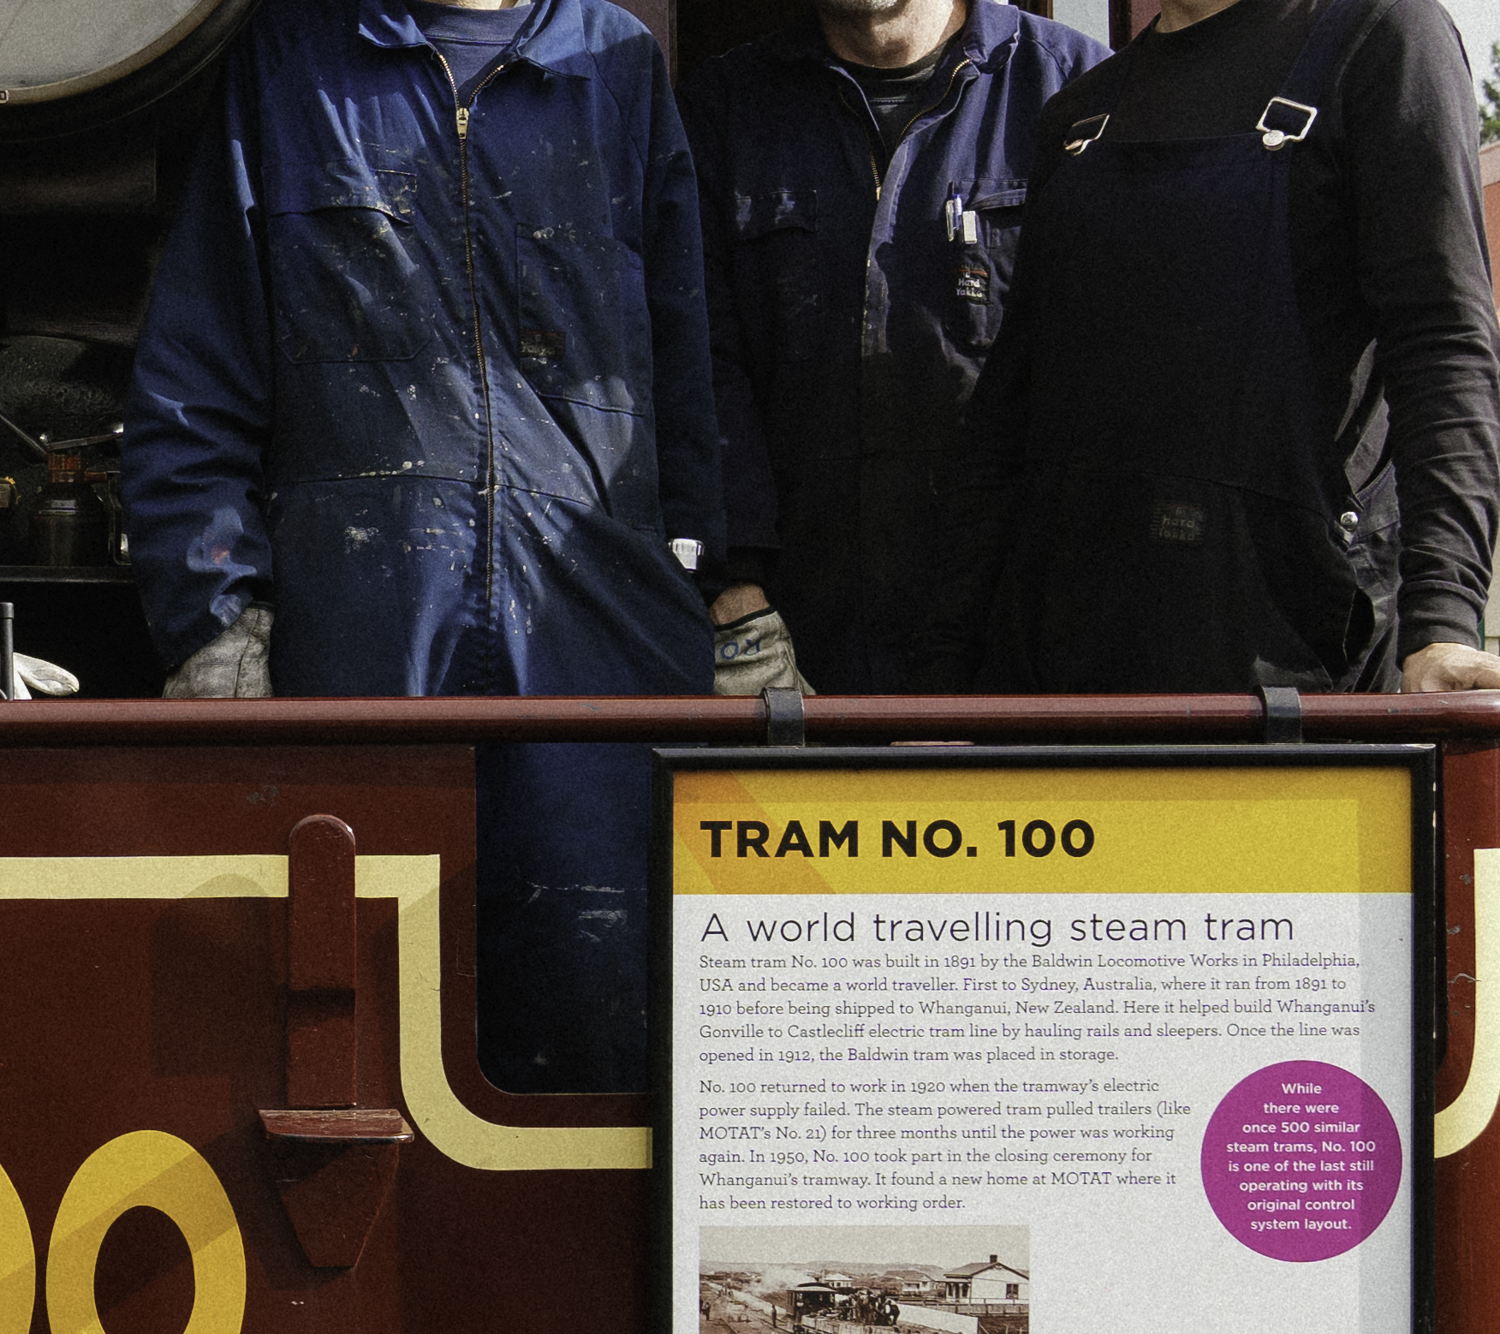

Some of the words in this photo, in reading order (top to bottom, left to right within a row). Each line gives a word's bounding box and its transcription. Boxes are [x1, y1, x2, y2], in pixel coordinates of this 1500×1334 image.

[958, 278, 981, 287] Hard
[700, 820, 858, 858] TRAM
[882, 819, 977, 858] NO.
[997, 819, 1095, 858] 100
[701, 913, 729, 942] A
[746, 911, 855, 942] world
[873, 911, 1051, 948] travelling
[1070, 913, 1186, 942] steam
[1204, 913, 1293, 941] tram
[699, 954, 746, 969] Steam
[750, 957, 787, 968] tram
[791, 954, 817, 968] No.
[822, 957, 848, 968] 100
[852, 958, 881, 968] was
[885, 953, 920, 968] built
[925, 955, 939, 968] in
[944, 954, 976, 970] 1891
[980, 953, 999, 971] by
[1003, 953, 1027, 968] the
[1032, 952, 1093, 968] Baldwin
[1097, 954, 1186, 968] Locomotive
[1189, 952, 1239, 967] Works
[1242, 954, 1258, 967] in
[1262, 952, 1360, 970] Philadelphia,
[699, 978, 734, 992] USA
[738, 977, 766, 992] and
[770, 976, 829, 992] became
[833, 982, 842, 992] a
[846, 976, 888, 991] world
[892, 976, 958, 992] traveller.
[963, 977, 997, 991] First
[1002, 980, 1017, 991] to
[1021, 976, 1079, 994] Sydney,
[1083, 976, 1157, 992] Australia,
[1160, 975, 1206, 991] where
[1210, 977, 1221, 990] it
[1225, 980, 1251, 990] ran
[1255, 975, 1291, 990] from
[1295, 977, 1327, 992] 1891
[1331, 979, 1346, 990] to
[699, 1004, 732, 1017] 1910
[736, 1000, 784, 1015] before
[787, 1000, 831, 1018] being
[835, 1000, 895, 1018] shipped
[899, 1003, 914, 1015] to
[918, 999, 1011, 1018] Whanganui,
[1015, 1001, 1050, 1014] New
[1054, 999, 1119, 1014] Zealand.
[1123, 1000, 1160, 1014] Here
[1164, 1001, 1174, 1014] it
[1179, 998, 1229, 1017] helped
[1233, 998, 1272, 1014] build
[1276, 998, 1375, 1017] Whanganui's
[1281, 1083, 1322, 1094] While
[1263, 1102, 1301, 1114] there
[1305, 1104, 1340, 1114] were
[1242, 1124, 1277, 1133] once
[1281, 1121, 1310, 1133] 500
[1314, 1121, 1361, 1133] similar
[1226, 1142, 1269, 1153] steam
[1273, 1142, 1317, 1154] trams,
[1322, 1141, 1346, 1152] No.
[1350, 1141, 1376, 1152] 100
[1228, 1160, 1240, 1172] is
[1243, 1163, 1270, 1172] one
[1274, 1160, 1289, 1172] of
[1292, 1160, 1316, 1172] the
[1320, 1160, 1345, 1172] last
[1349, 1160, 1374, 1171] still
[1239, 1180, 1308, 1193] operating
[1312, 1179, 1343, 1191] with
[1347, 1179, 1364, 1191] its
[1247, 1199, 1301, 1213] original
[1305, 1199, 1355, 1210] control
[1250, 1219, 1300, 1232] system
[1304, 1218, 1352, 1232] layout.
